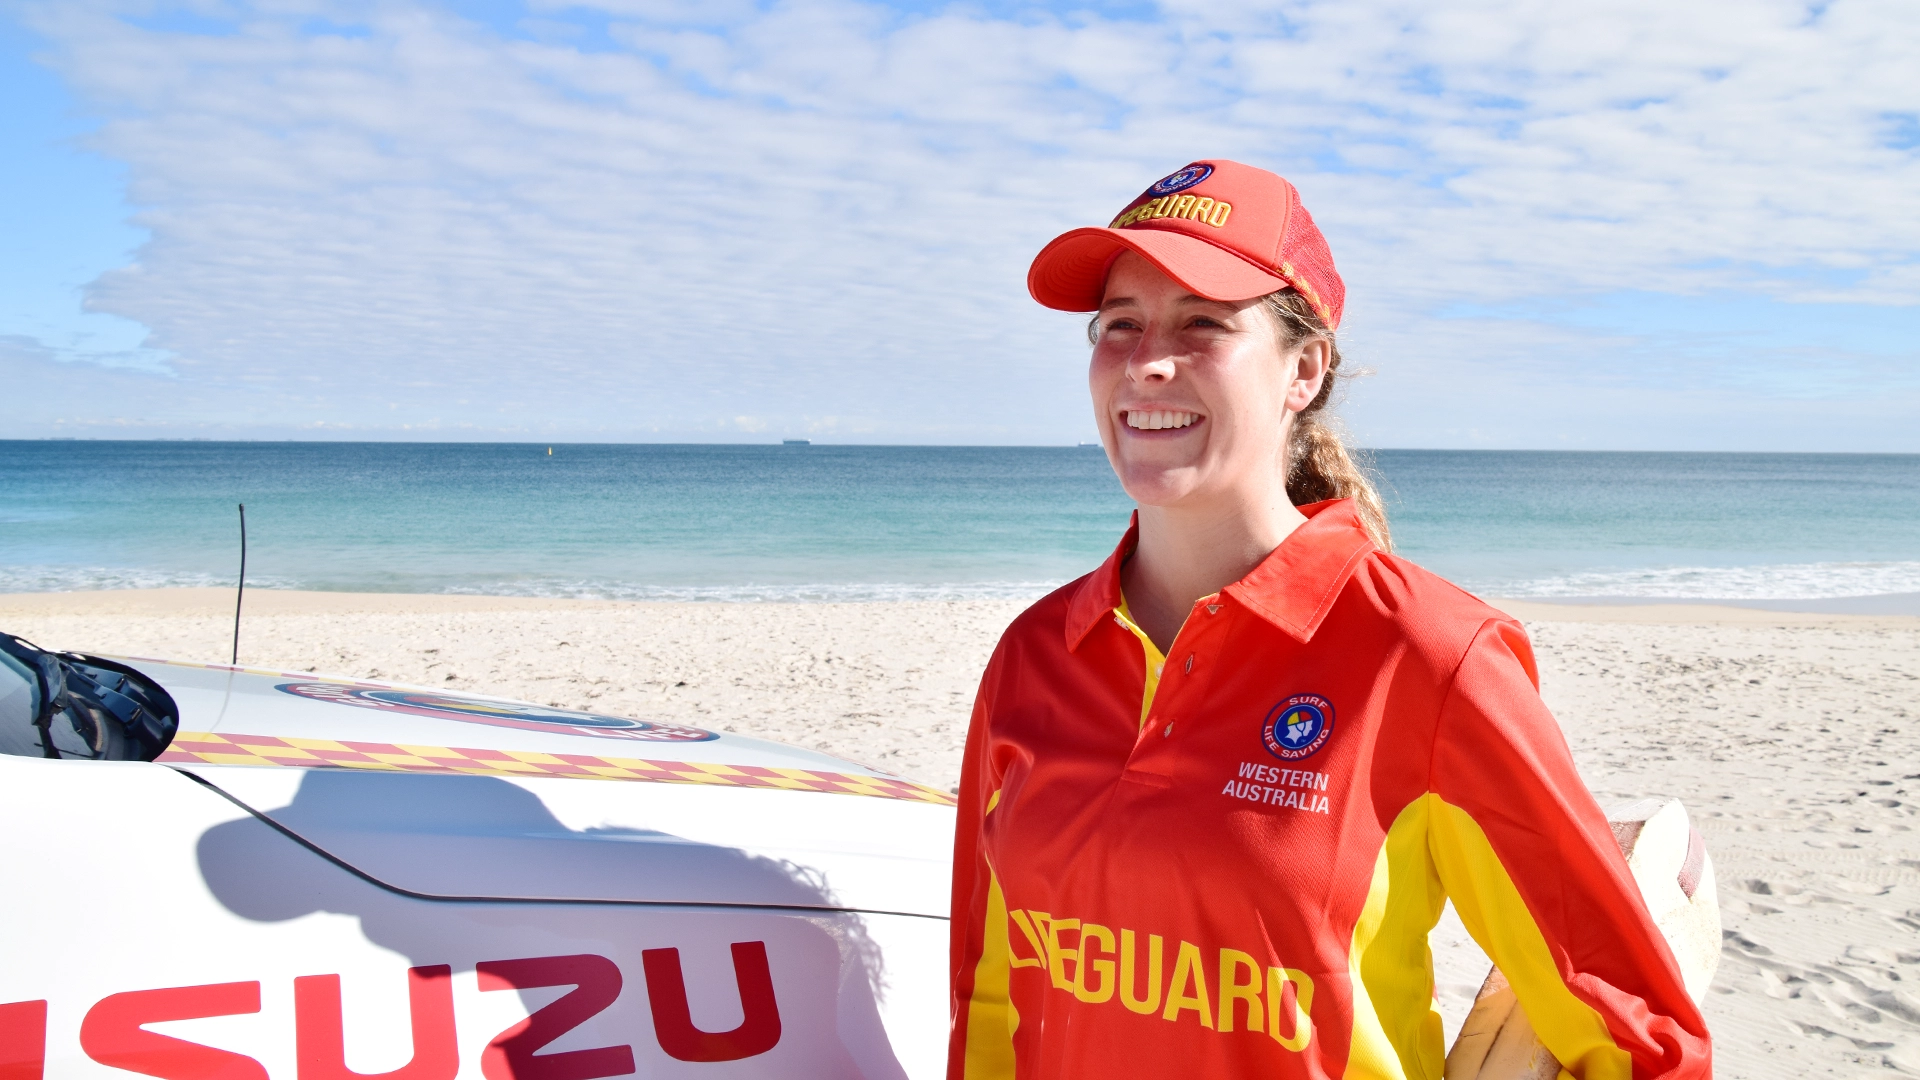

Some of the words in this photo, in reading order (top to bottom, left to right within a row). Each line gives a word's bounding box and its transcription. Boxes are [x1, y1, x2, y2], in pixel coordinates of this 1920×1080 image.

[1111, 194, 1232, 228] FEGUARD
[1289, 696, 1328, 709] SURF
[1264, 725, 1280, 751] LIFE
[1281, 729, 1329, 758] SAVING
[1238, 761, 1329, 791] WESTERN
[1222, 779, 1329, 814] AUSTRALIA
